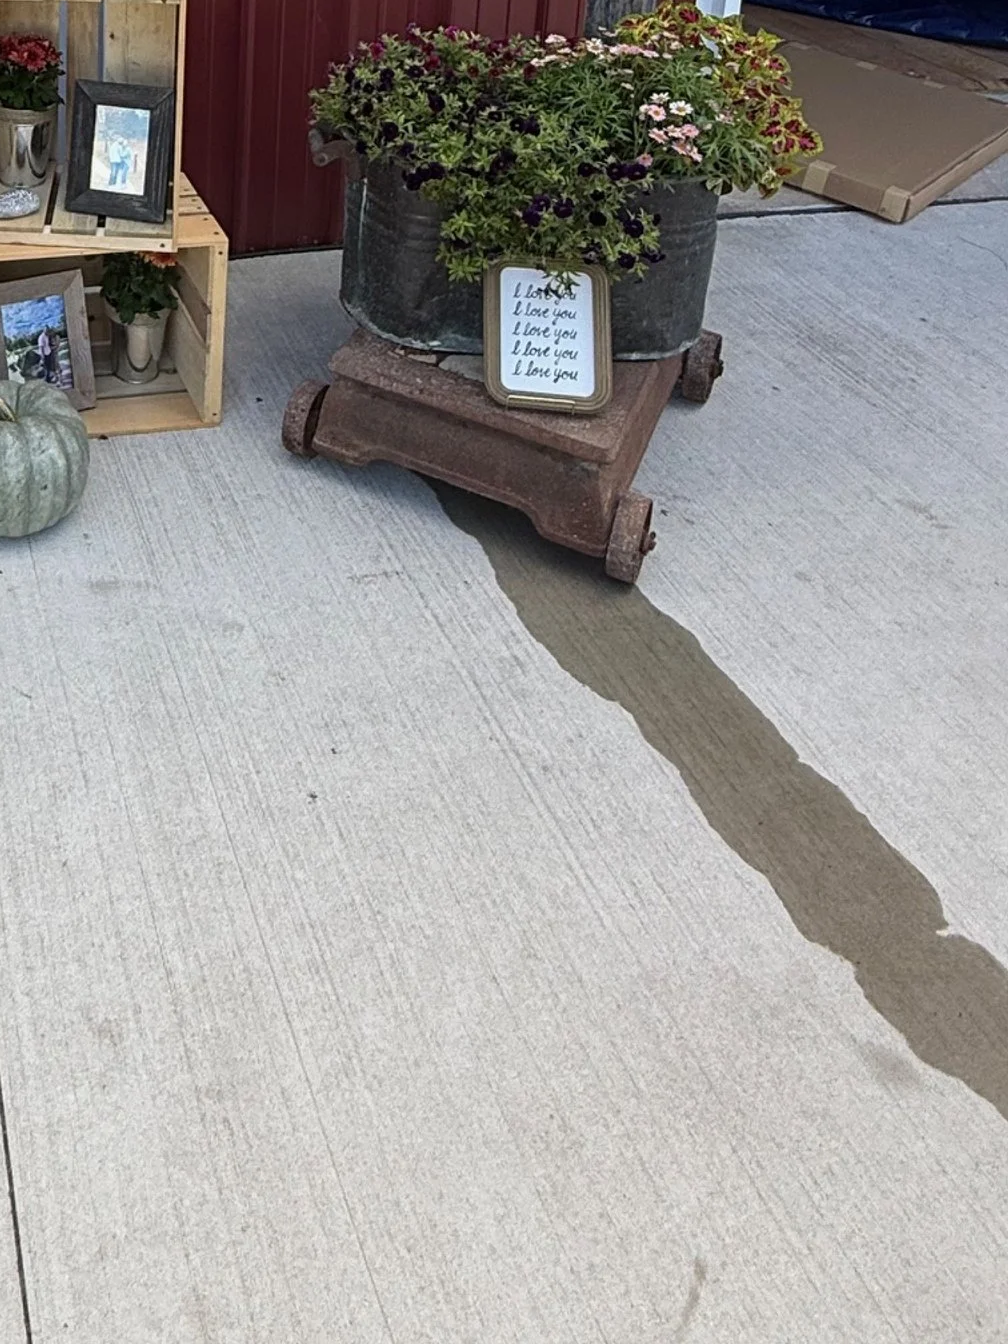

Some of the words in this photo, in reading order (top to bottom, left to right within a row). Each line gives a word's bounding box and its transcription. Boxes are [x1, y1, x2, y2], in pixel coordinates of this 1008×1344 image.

[524, 302, 549, 318] love
[552, 308, 577, 325] you
[523, 322, 551, 338] love
[554, 329, 577, 345] you
[522, 341, 550, 357] love
[554, 348, 578, 365] you
[525, 360, 551, 377] love
[553, 368, 578, 383] you
